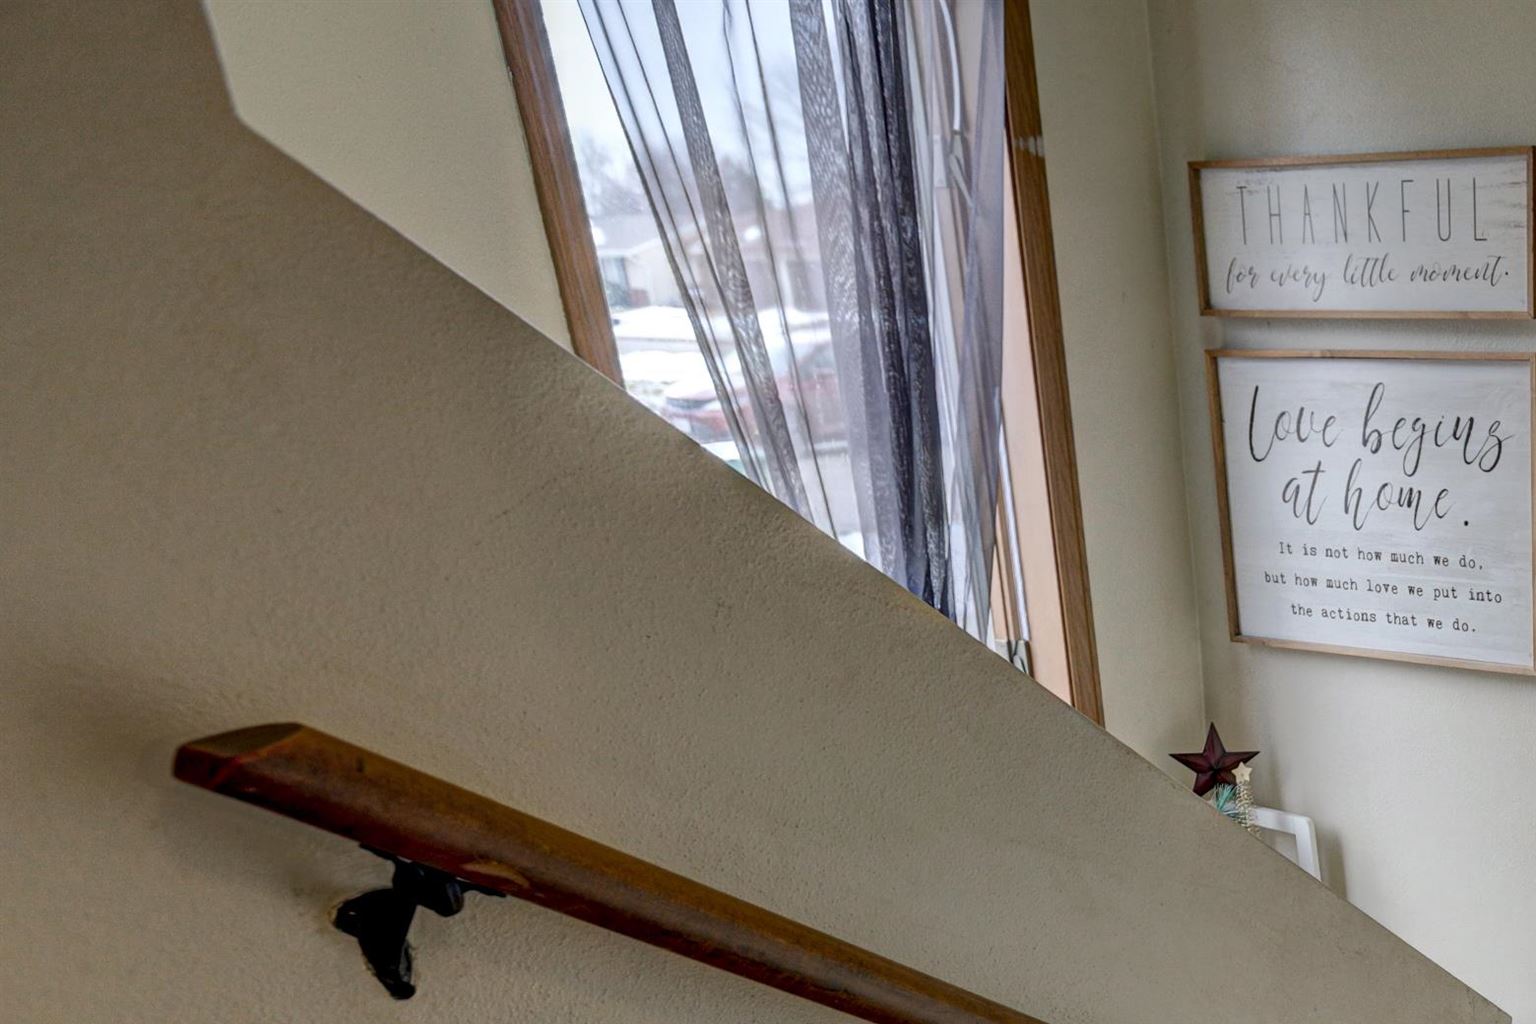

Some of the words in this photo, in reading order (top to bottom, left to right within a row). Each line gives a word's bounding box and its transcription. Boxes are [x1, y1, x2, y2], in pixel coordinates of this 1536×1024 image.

[1236, 177, 1488, 245] THANKFUL
[1226, 257, 1260, 294] for
[1270, 265, 1327, 302] every
[1344, 253, 1397, 287] little
[1410, 254, 1509, 287] moment.
[1362, 382, 1514, 477] begins
[1281, 460, 1326, 525] at
[1344, 458, 1469, 531] home.
[1279, 542, 1293, 555] It
[1302, 544, 1317, 557] is
[1325, 548, 1349, 560] not
[1357, 547, 1382, 562] how
[1390, 552, 1425, 566] much
[1433, 556, 1449, 568] we
[1264, 571, 1287, 585] but
[1294, 573, 1318, 588] how
[1326, 577, 1358, 592] much
[1366, 579, 1398, 596] love
[1408, 585, 1424, 598] we
[1433, 587, 1458, 602] put
[1468, 589, 1503, 604] into
[1291, 604, 1313, 618] the
[1321, 607, 1377, 623] actions
[1386, 612, 1418, 628] that
[1427, 617, 1443, 630] we
[1452, 619, 1477, 634] do.
